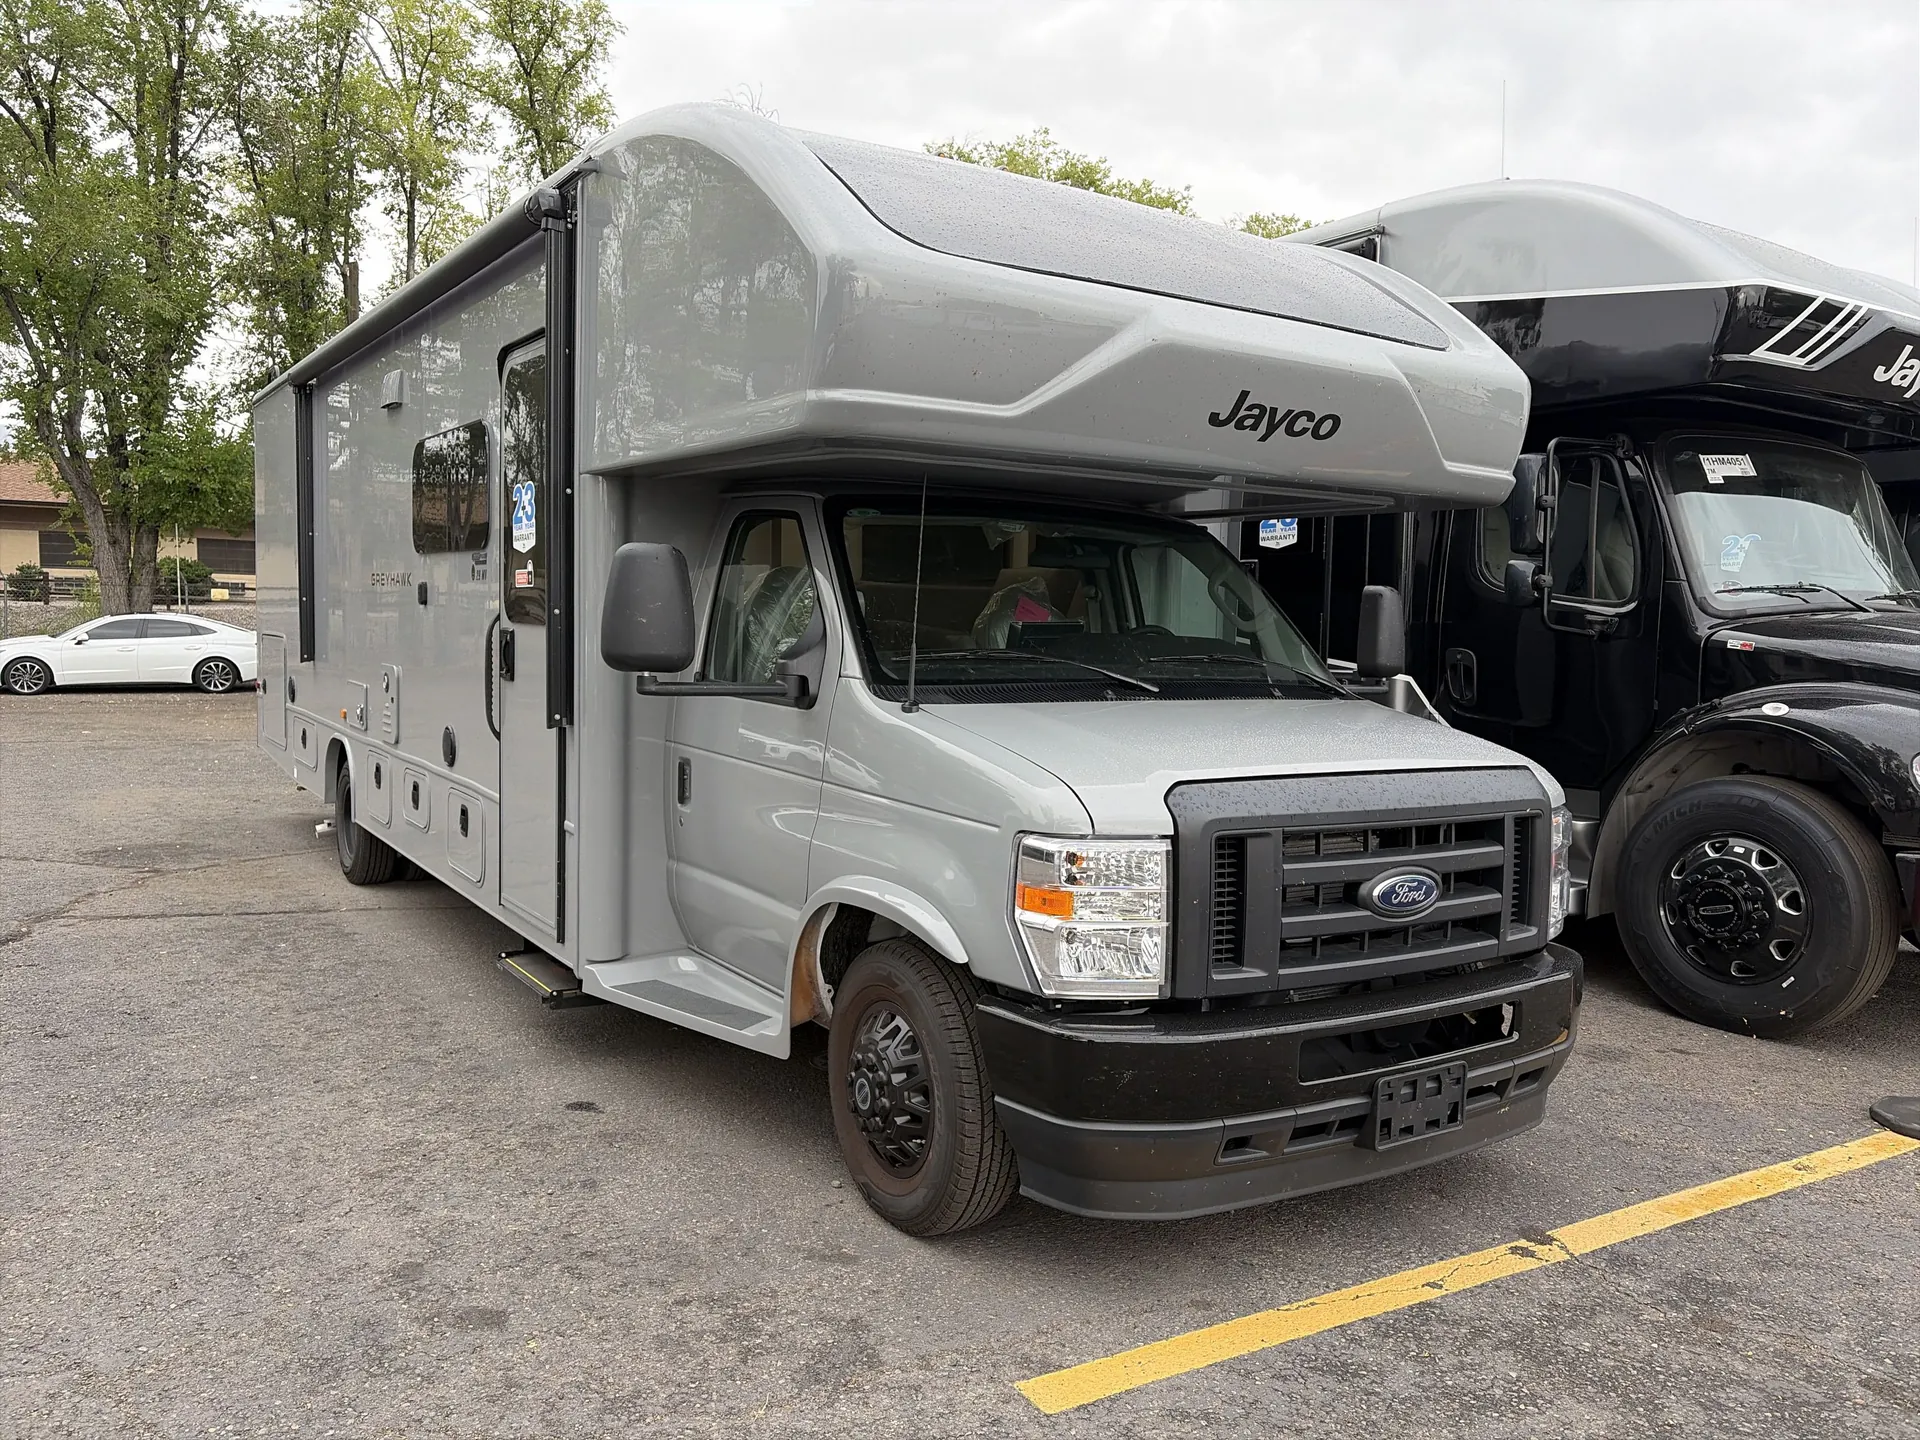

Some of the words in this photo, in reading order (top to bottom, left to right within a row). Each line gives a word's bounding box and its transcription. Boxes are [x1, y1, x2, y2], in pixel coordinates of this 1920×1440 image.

[1208, 389, 1342, 443] Jayco
[514, 533, 534, 542] WARRANTY
[370, 571, 412, 587] GREYHAWK
[1391, 881, 1426, 905] Ford
